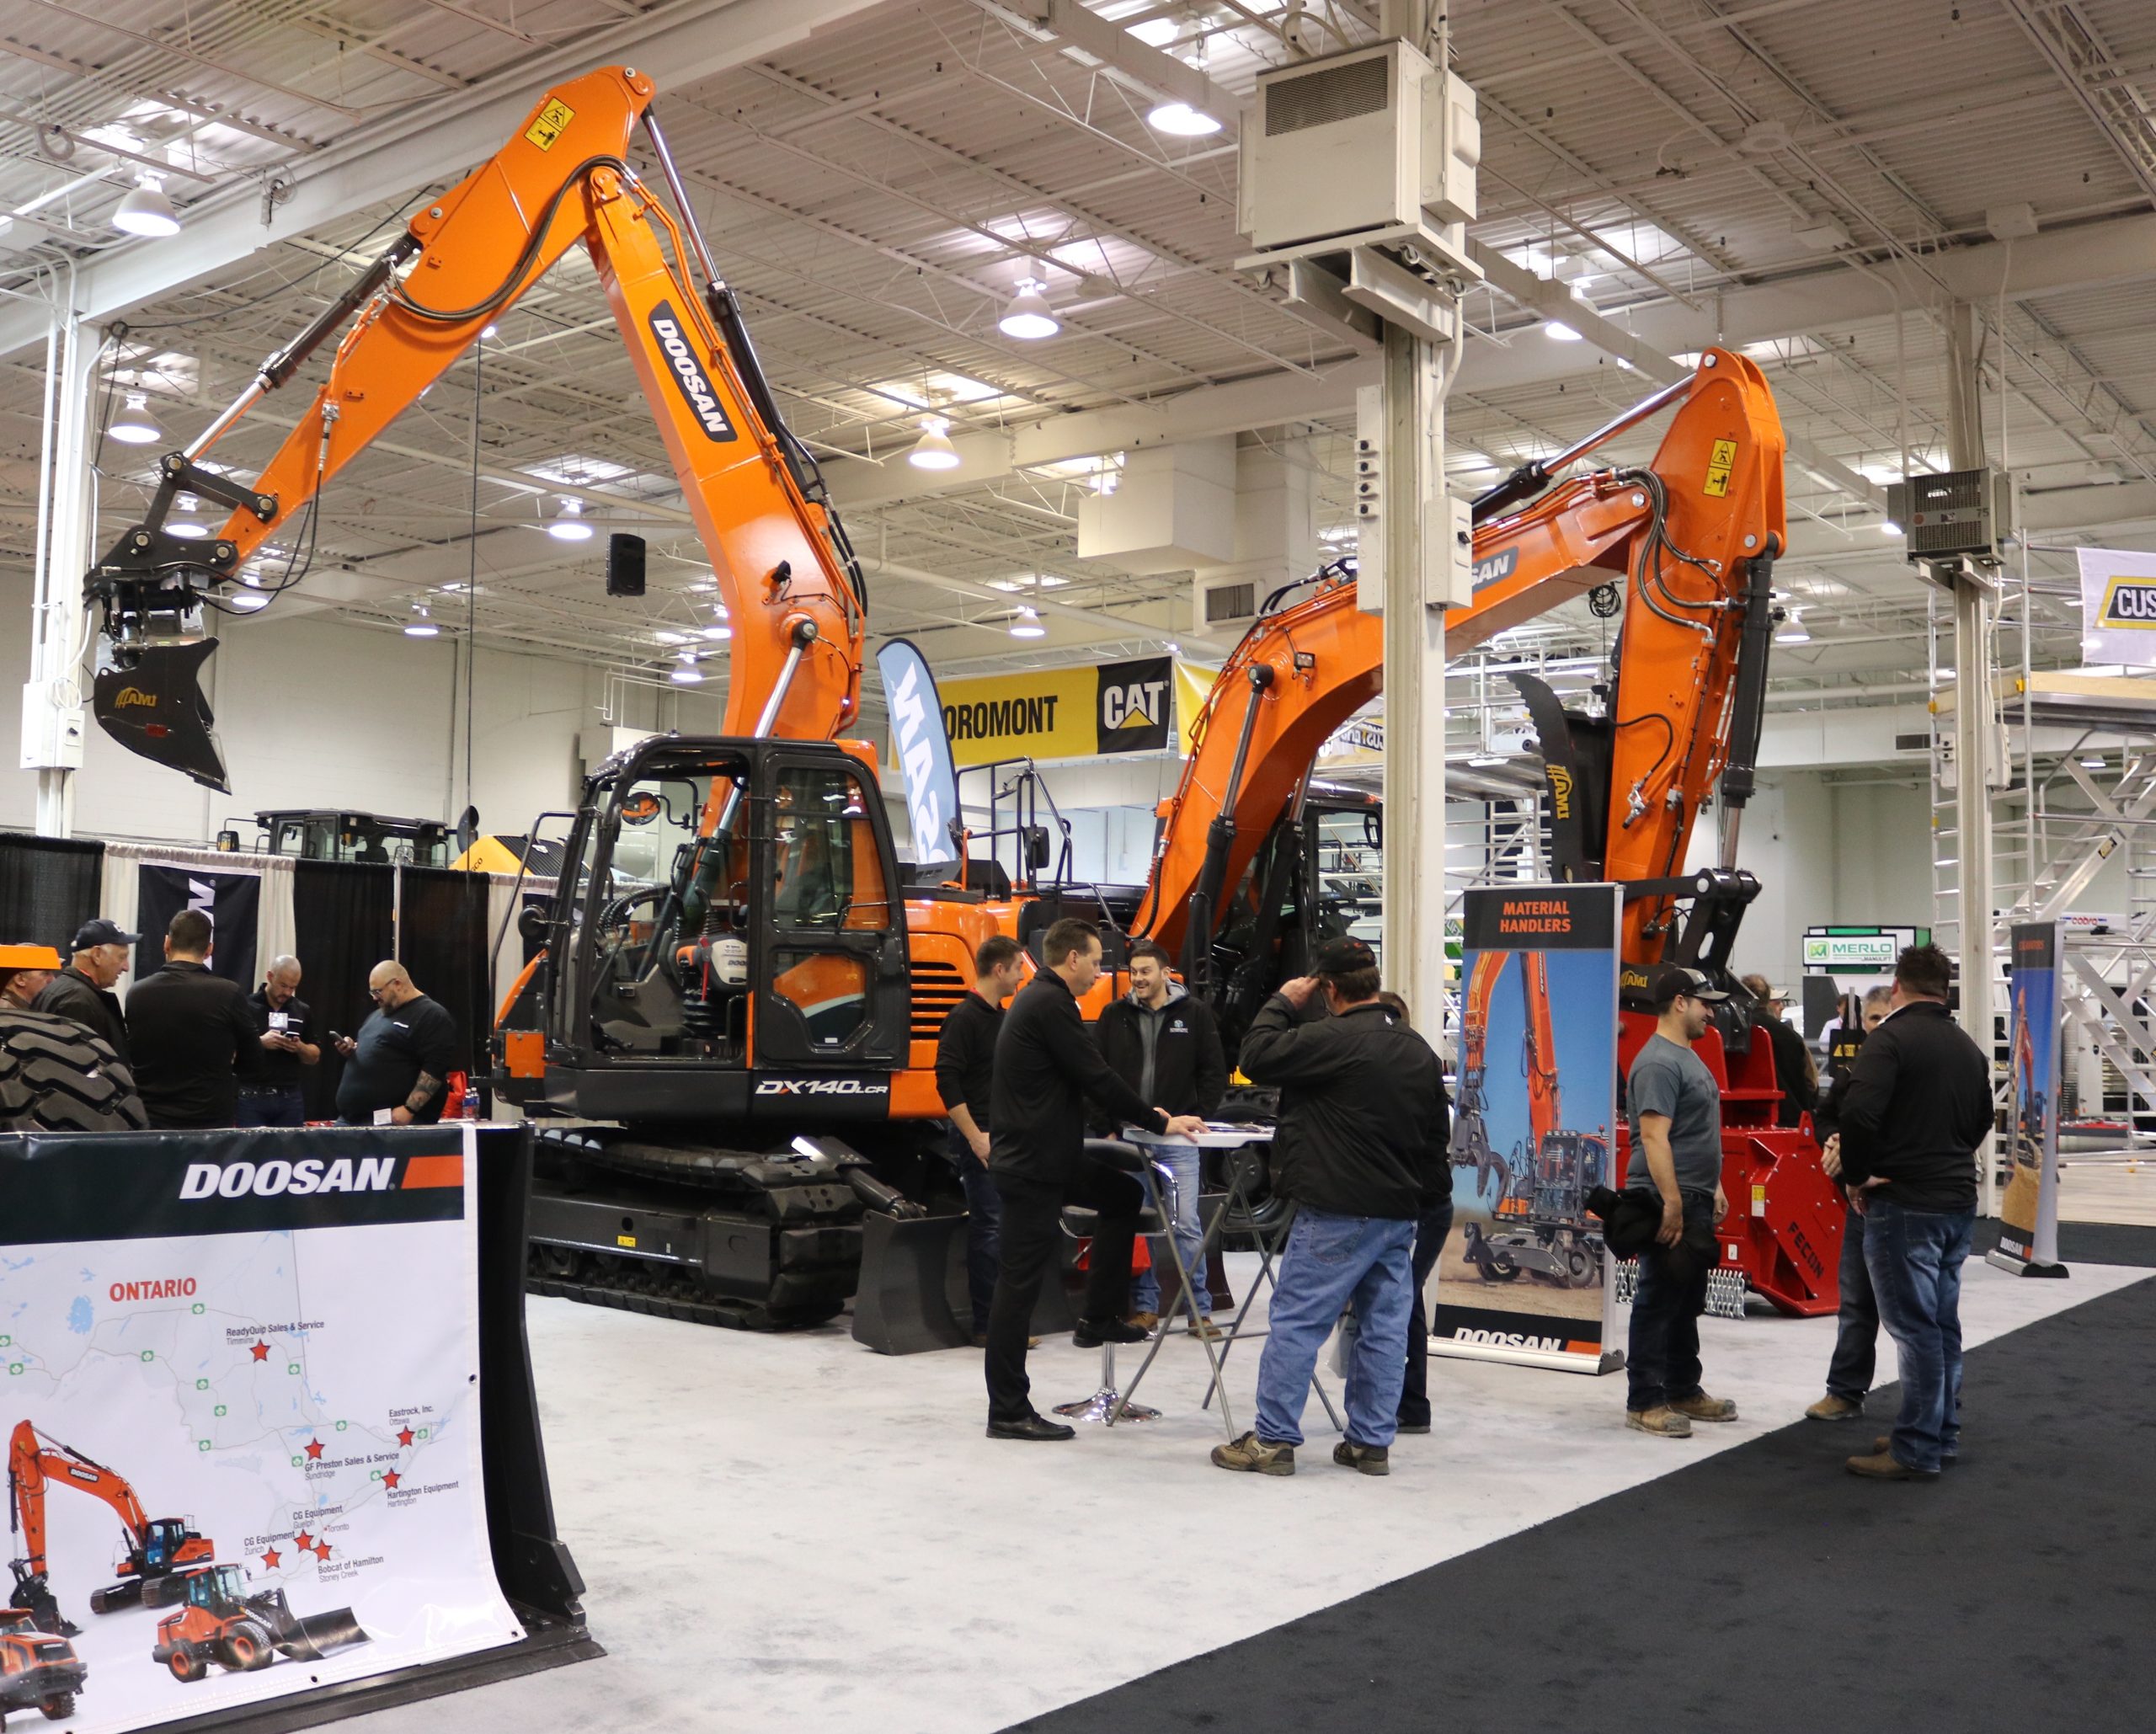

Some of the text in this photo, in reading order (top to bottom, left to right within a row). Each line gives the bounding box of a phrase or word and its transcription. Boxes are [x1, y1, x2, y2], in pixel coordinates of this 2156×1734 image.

[653, 319, 728, 432] DOOSAN
[1103, 680, 1165, 730] CAT
[1502, 901, 1570, 915] MATERIAL
[1500, 918, 1572, 932] HANDLERS
[2072, 917, 2098, 926] cobra
[1833, 944, 1892, 953] MERLO
[179, 1158, 395, 1200] DOOSAN
[1787, 1221, 1824, 1279] FECON
[109, 1278, 197, 1302] ONTARIO
[227, 1326, 266, 1337] ReadyQuip
[269, 1324, 288, 1332] Sales
[297, 1321, 324, 1331] Service
[1454, 1327, 1561, 1352] DOOSAN
[389, 1407, 420, 1417] Eastrock,
[305, 1463, 314, 1472] GF
[316, 1459, 343, 1470] Preston
[344, 1457, 364, 1465] Sales
[374, 1453, 399, 1462] Service
[305, 1470, 335, 1481] Sundridge
[387, 1481, 459, 1499] Hartington Equipment
[387, 1497, 417, 1507] Hartington
[293, 1505, 343, 1520] CG Equipment
[293, 1519, 315, 1529] Guelph
[328, 1523, 350, 1533] Toronto
[244, 1530, 295, 1546] CG Equipment
[244, 1545, 264, 1555] Zurich
[318, 1556, 384, 1574] Bobcat of Hamilton
[319, 1570, 359, 1582] Stoney Creek
